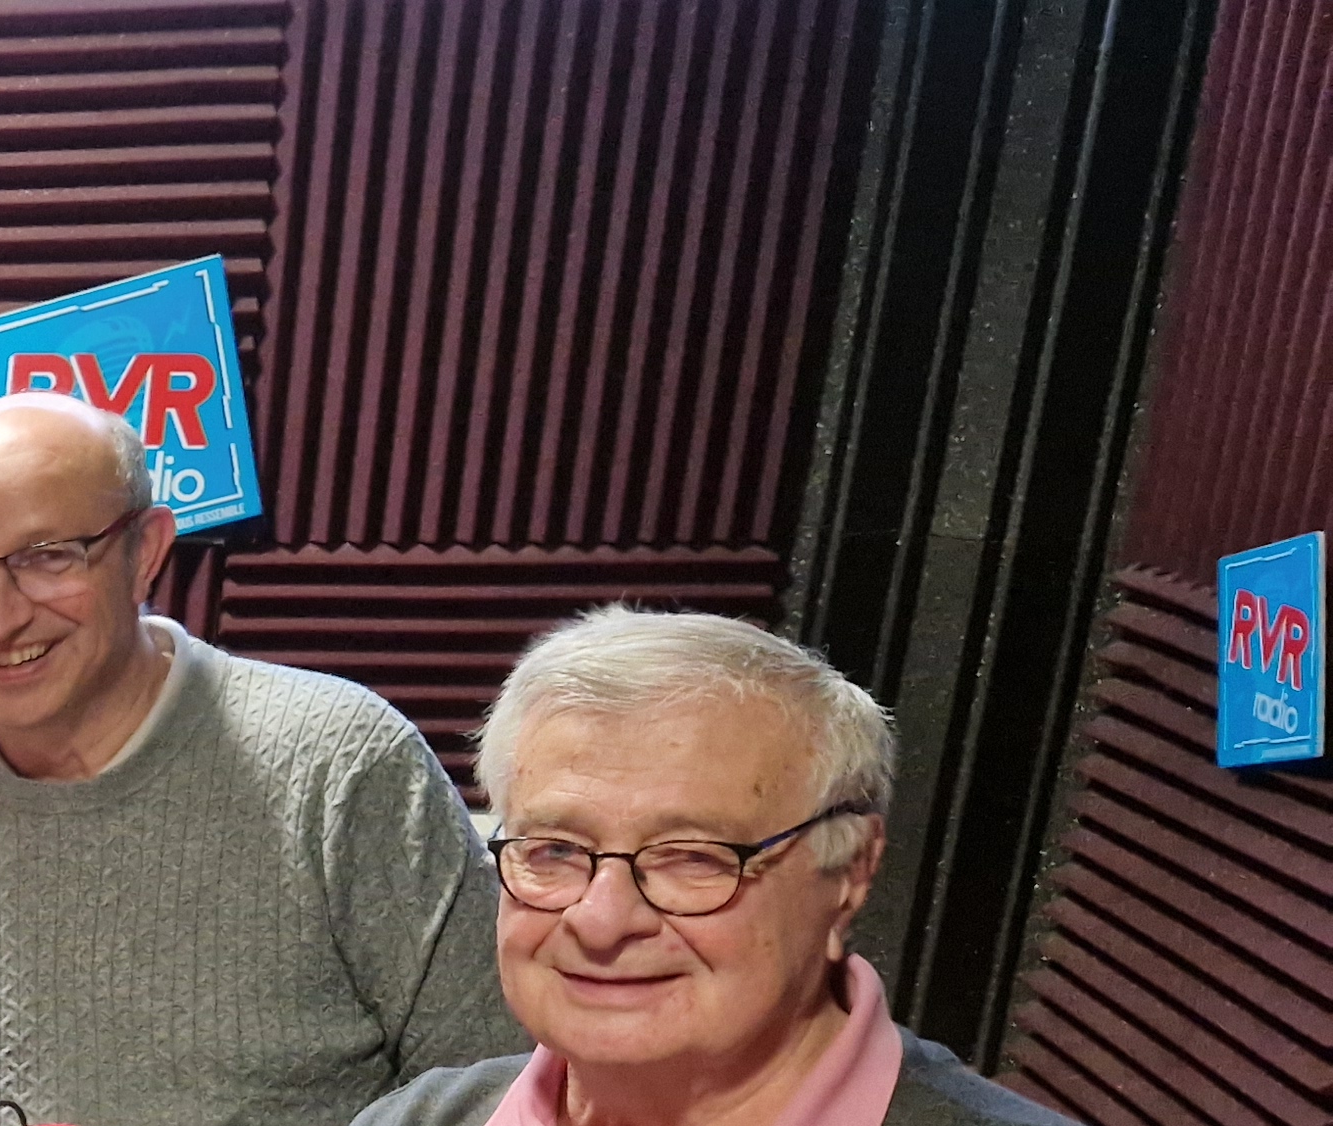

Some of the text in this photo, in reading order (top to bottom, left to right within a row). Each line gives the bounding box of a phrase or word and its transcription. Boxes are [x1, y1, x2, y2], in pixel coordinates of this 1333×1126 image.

[146, 450, 205, 503] dio
[1228, 588, 1310, 691] RVR
[1252, 687, 1299, 734] radio
